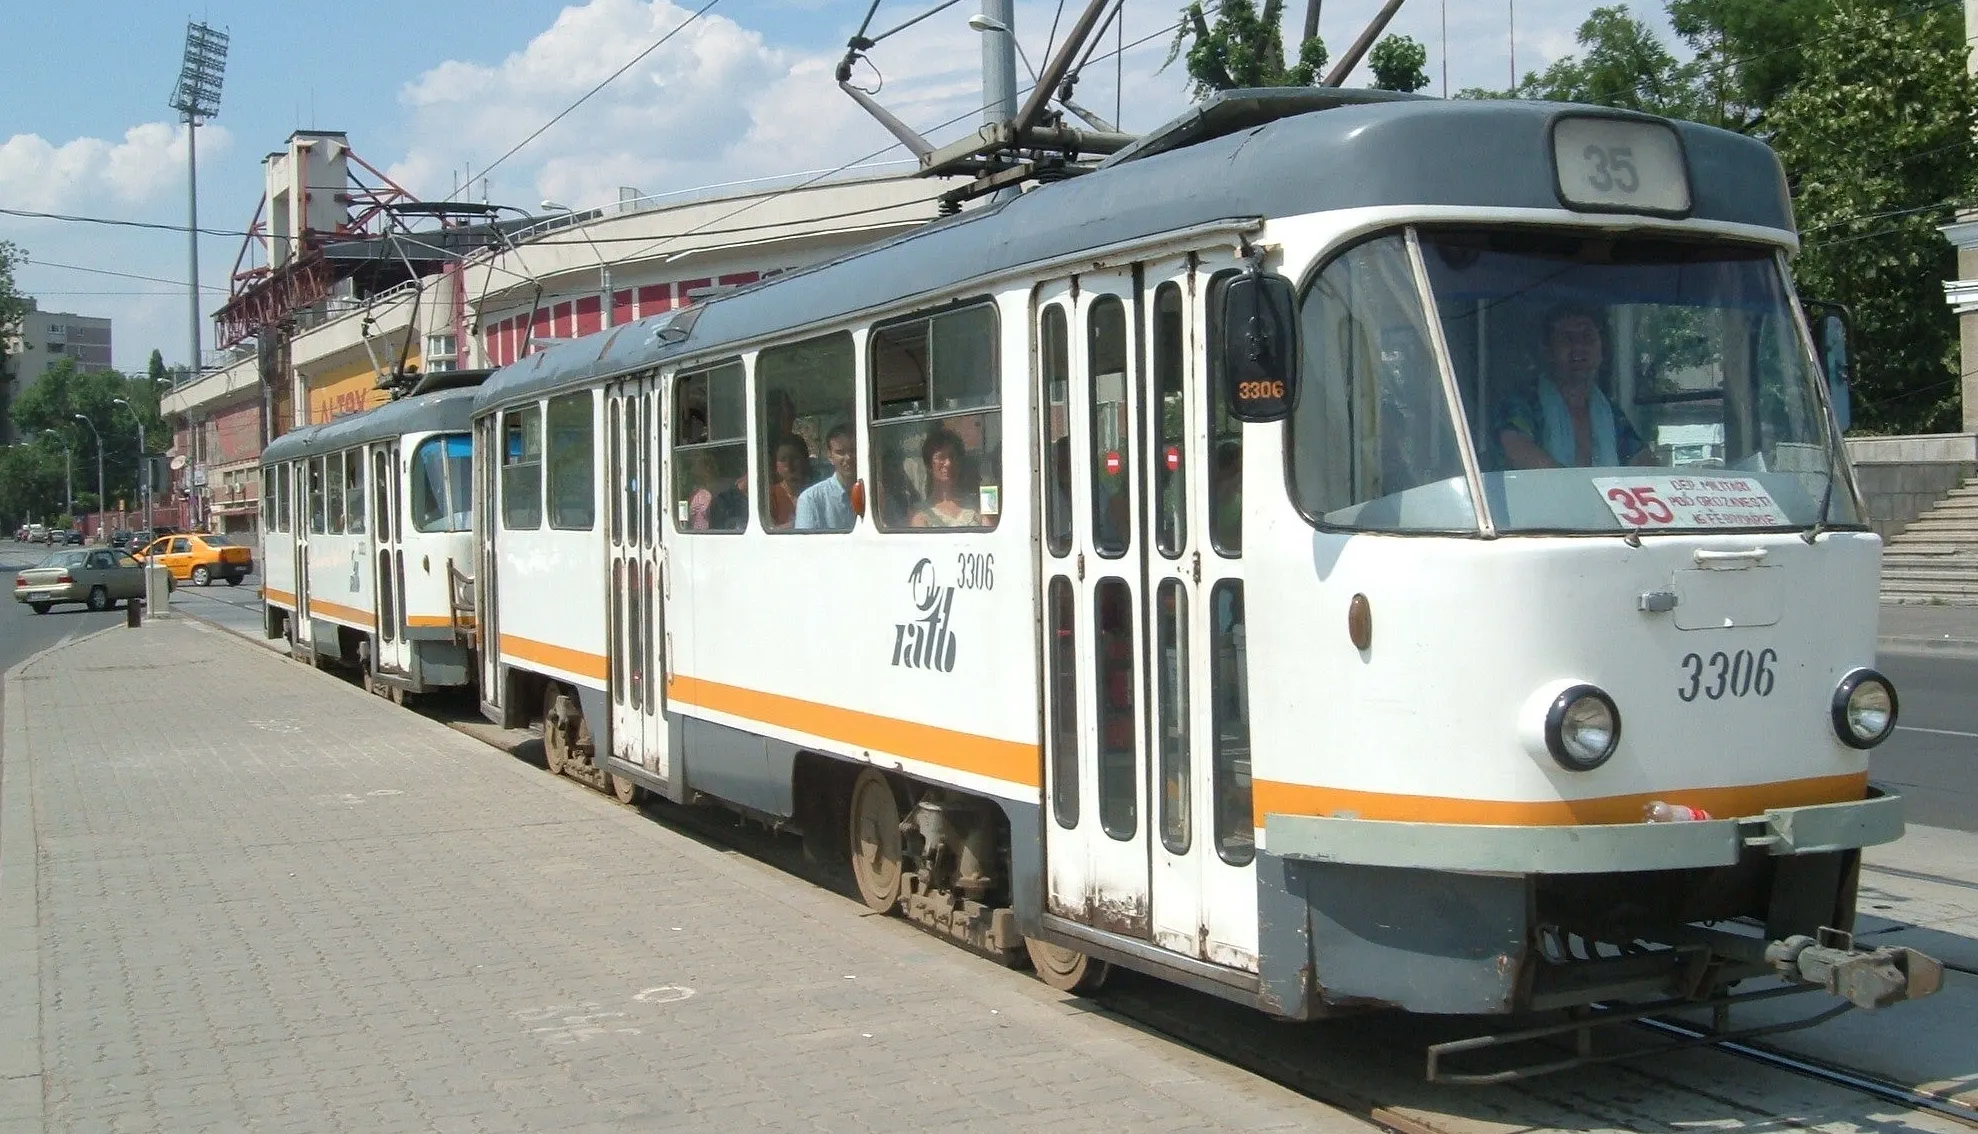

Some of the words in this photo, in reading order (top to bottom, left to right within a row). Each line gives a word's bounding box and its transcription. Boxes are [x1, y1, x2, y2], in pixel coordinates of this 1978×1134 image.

[1583, 144, 1640, 194] 35
[1238, 381, 1285, 399] 3306
[1606, 486, 1674, 526] 35
[957, 552, 994, 591] 3306
[1678, 648, 1778, 702] 3306
